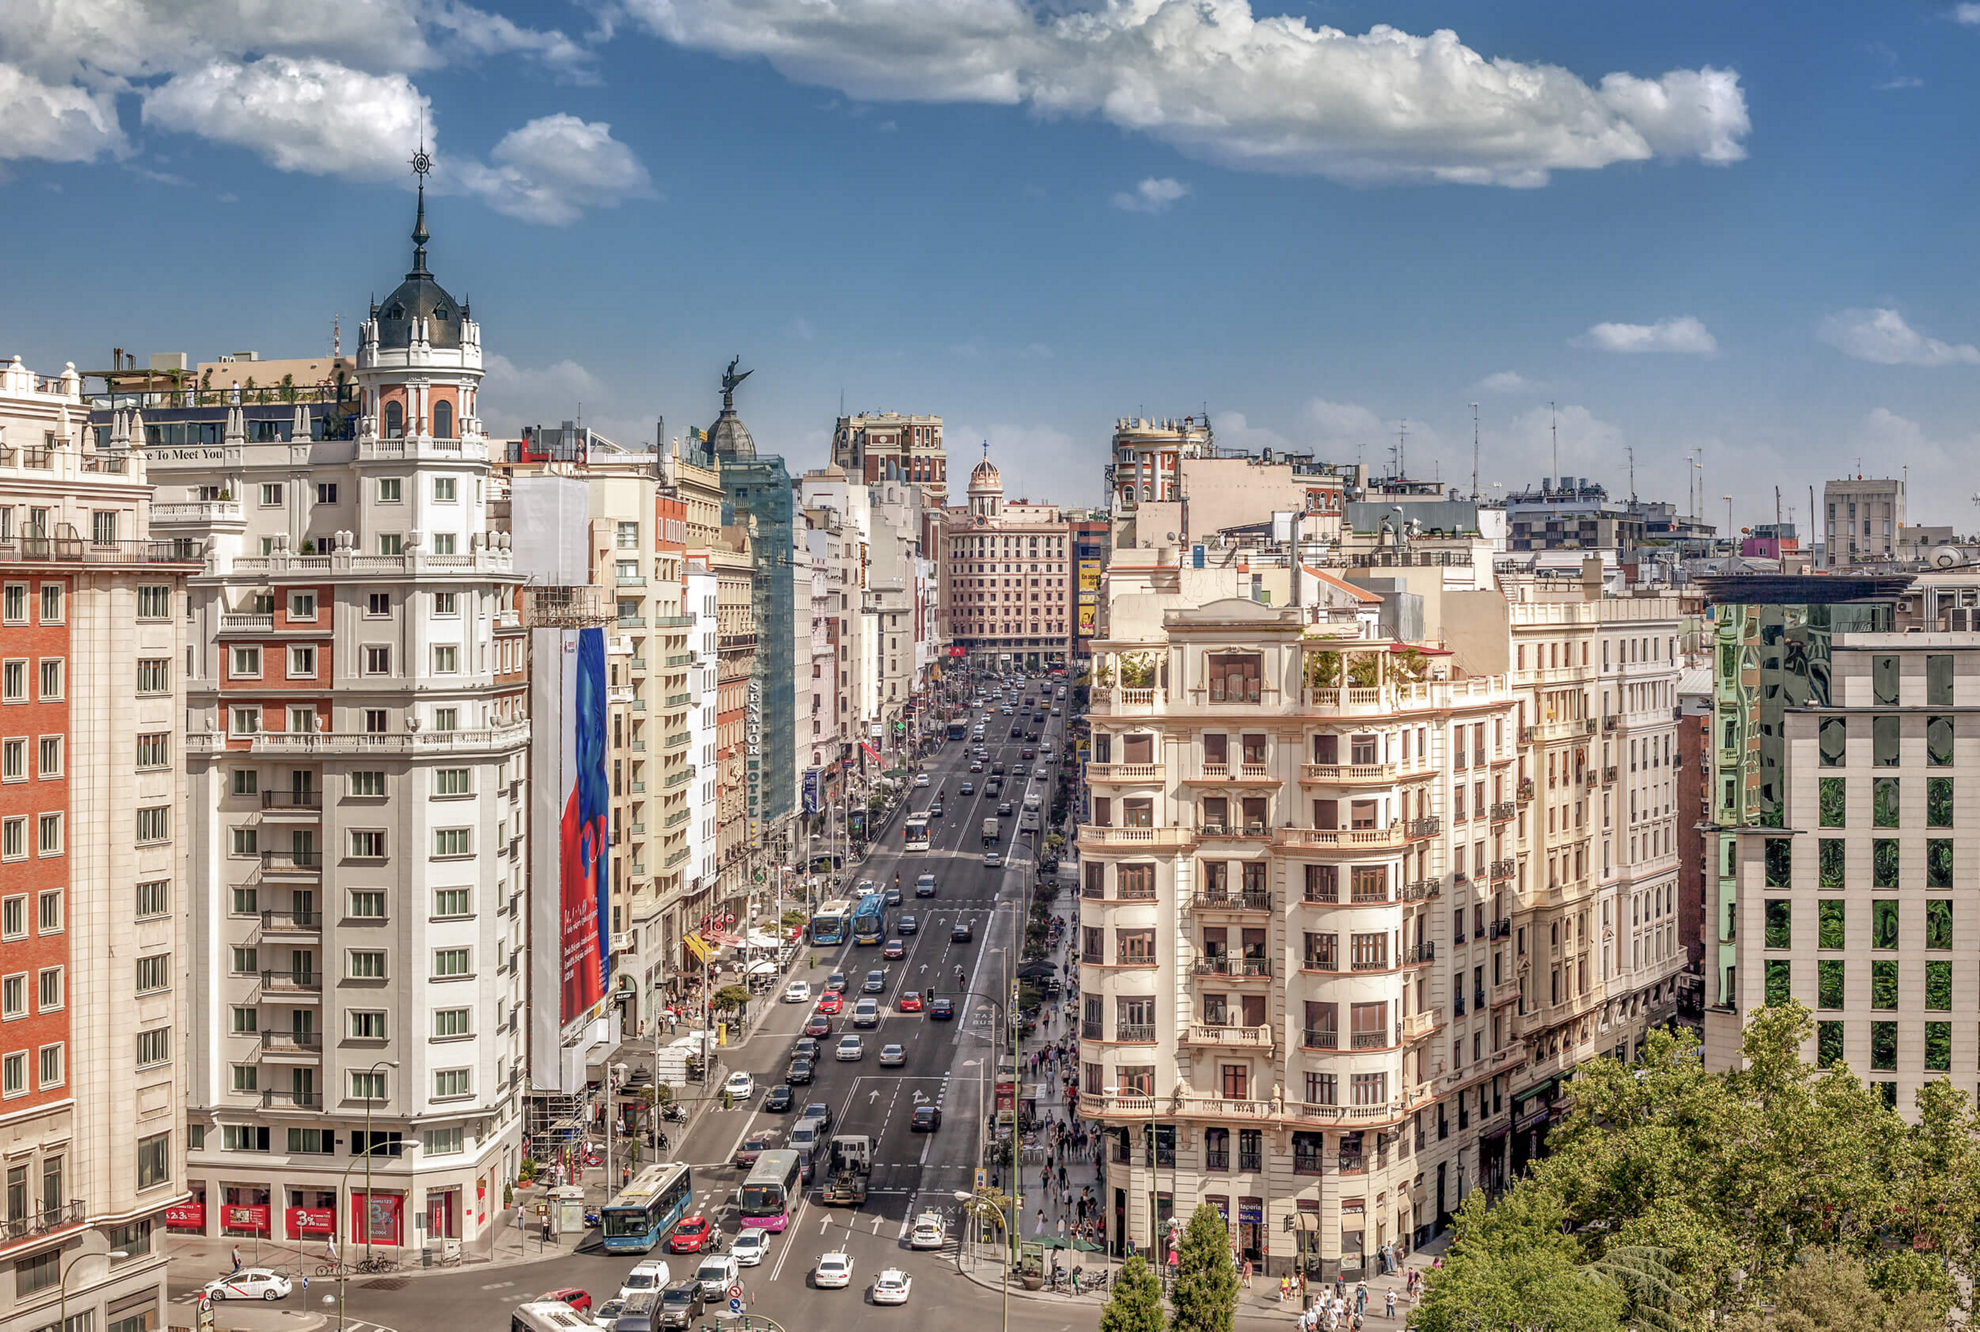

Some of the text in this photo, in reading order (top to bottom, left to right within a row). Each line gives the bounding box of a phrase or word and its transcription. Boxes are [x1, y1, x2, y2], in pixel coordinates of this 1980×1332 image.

[155, 450, 169, 460] To
[172, 449, 199, 460] Meet
[203, 448, 223, 459] You
[747, 681, 760, 818] SENATOR HOTEL
[296, 1210, 316, 1227] 3%
[370, 1204, 394, 1224] 3%
[924, 1206, 962, 1214] TAXI
